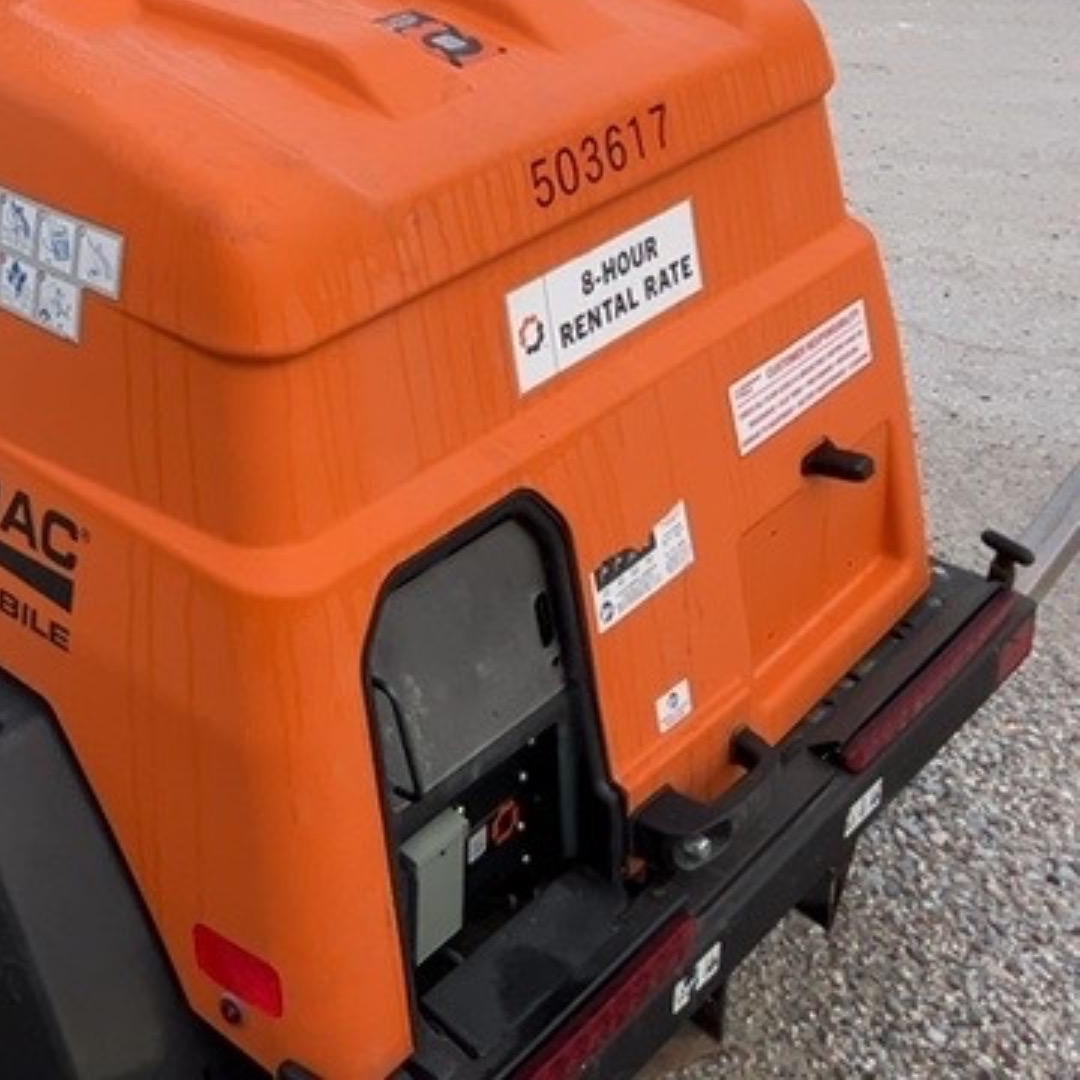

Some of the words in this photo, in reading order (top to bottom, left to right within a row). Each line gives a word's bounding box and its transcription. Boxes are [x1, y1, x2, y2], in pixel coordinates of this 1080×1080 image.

[530, 102, 668, 208] 503617
[559, 286, 639, 348] RENTAL
[645, 255, 693, 300] RATE
[581, 236, 658, 295] 8-HOUR
